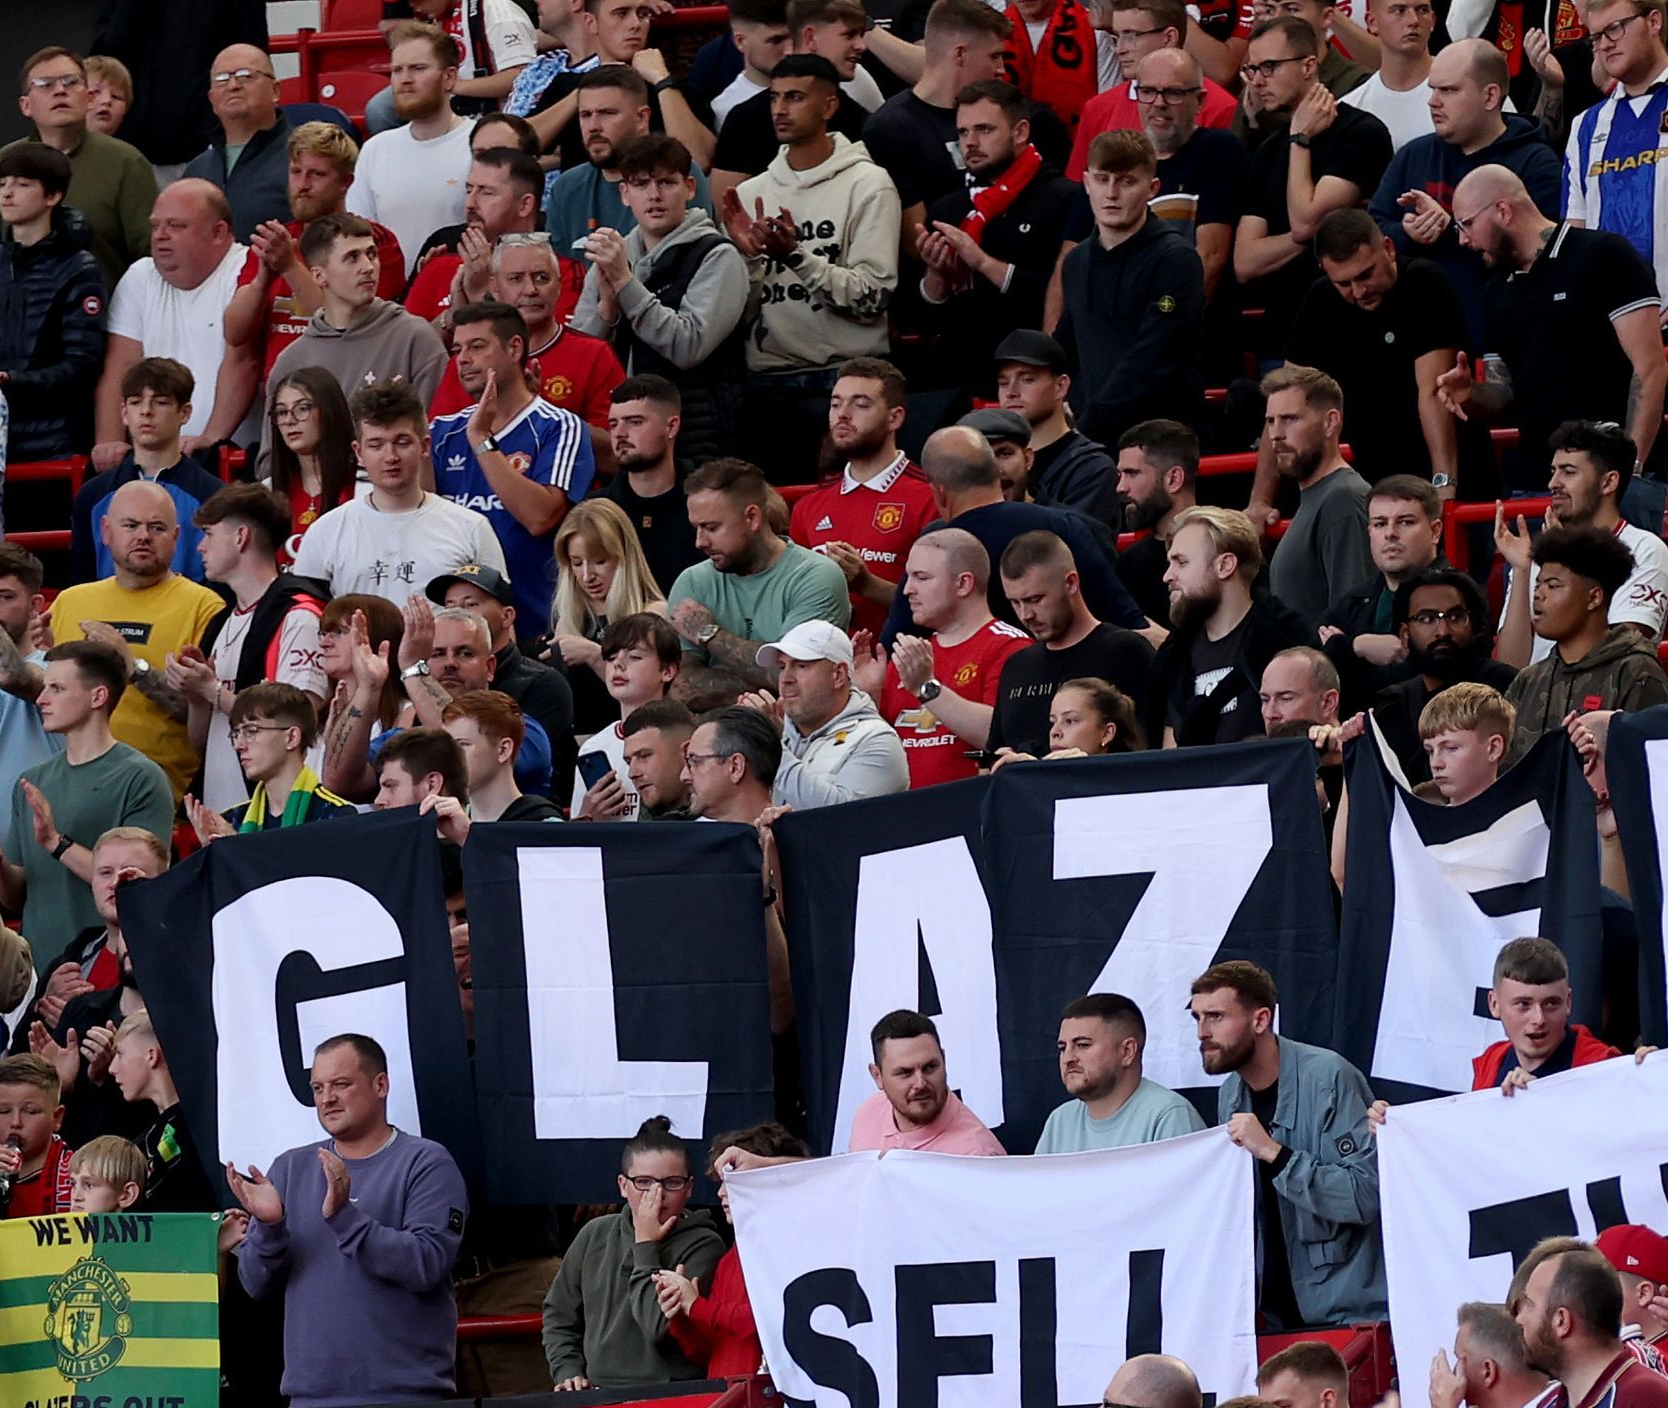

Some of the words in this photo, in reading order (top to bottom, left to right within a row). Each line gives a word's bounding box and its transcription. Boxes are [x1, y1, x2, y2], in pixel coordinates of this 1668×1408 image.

[28, 1217, 72, 1247] WE
[74, 1214, 154, 1245] WANT
[51, 1264, 124, 1309] MANCHESTER
